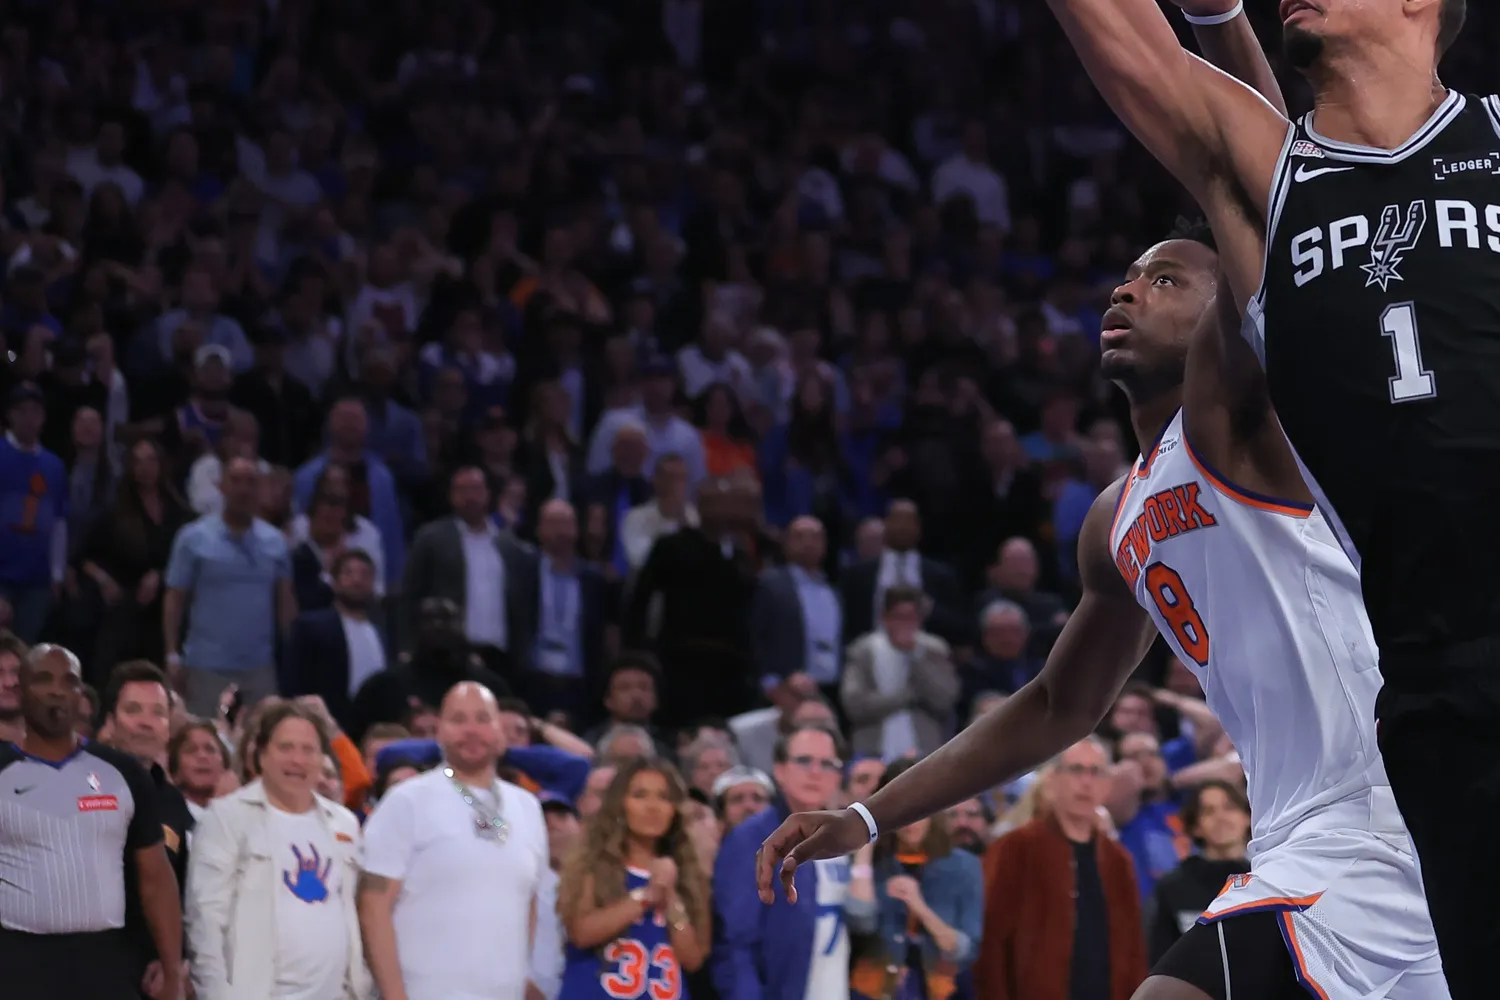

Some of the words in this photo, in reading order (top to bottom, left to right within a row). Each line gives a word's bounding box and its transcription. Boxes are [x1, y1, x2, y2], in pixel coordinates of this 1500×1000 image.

[1442, 159, 1492, 174] LEDGER
[1379, 300, 1438, 404] 1
[1144, 481, 1219, 544] ORK
[1145, 561, 1210, 667] 8
[600, 938, 682, 999] 33
